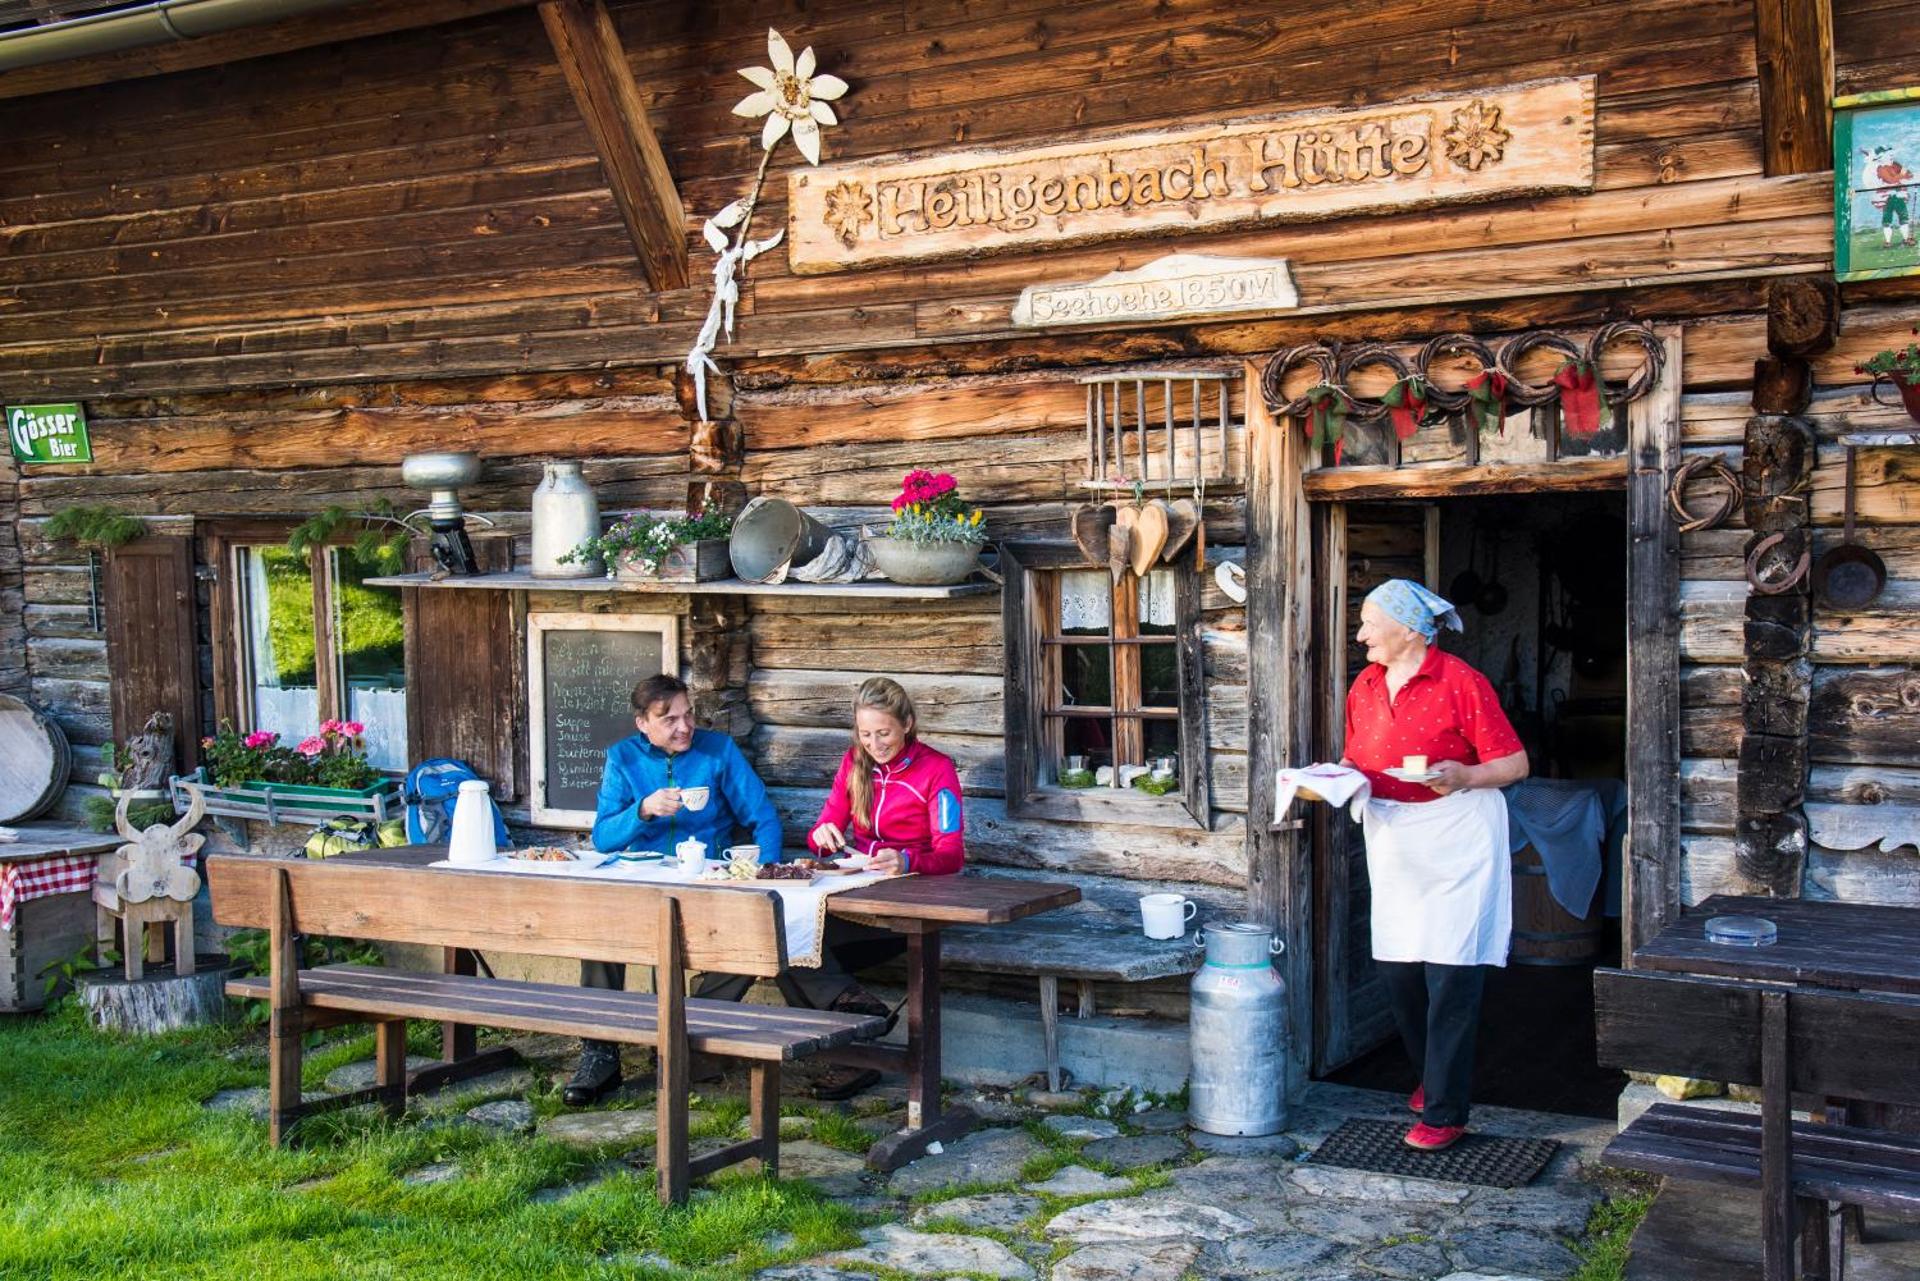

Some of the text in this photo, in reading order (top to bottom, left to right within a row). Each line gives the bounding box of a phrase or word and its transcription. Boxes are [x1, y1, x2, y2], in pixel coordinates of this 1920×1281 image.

[881, 125, 1429, 235] Heiligenbach Hütte
[1034, 284, 1172, 320] Seehoehe
[13, 408, 76, 457] Gösser
[49, 437, 77, 457] Bier
[556, 713, 591, 732] Suppe
[557, 730, 592, 741] Jause
